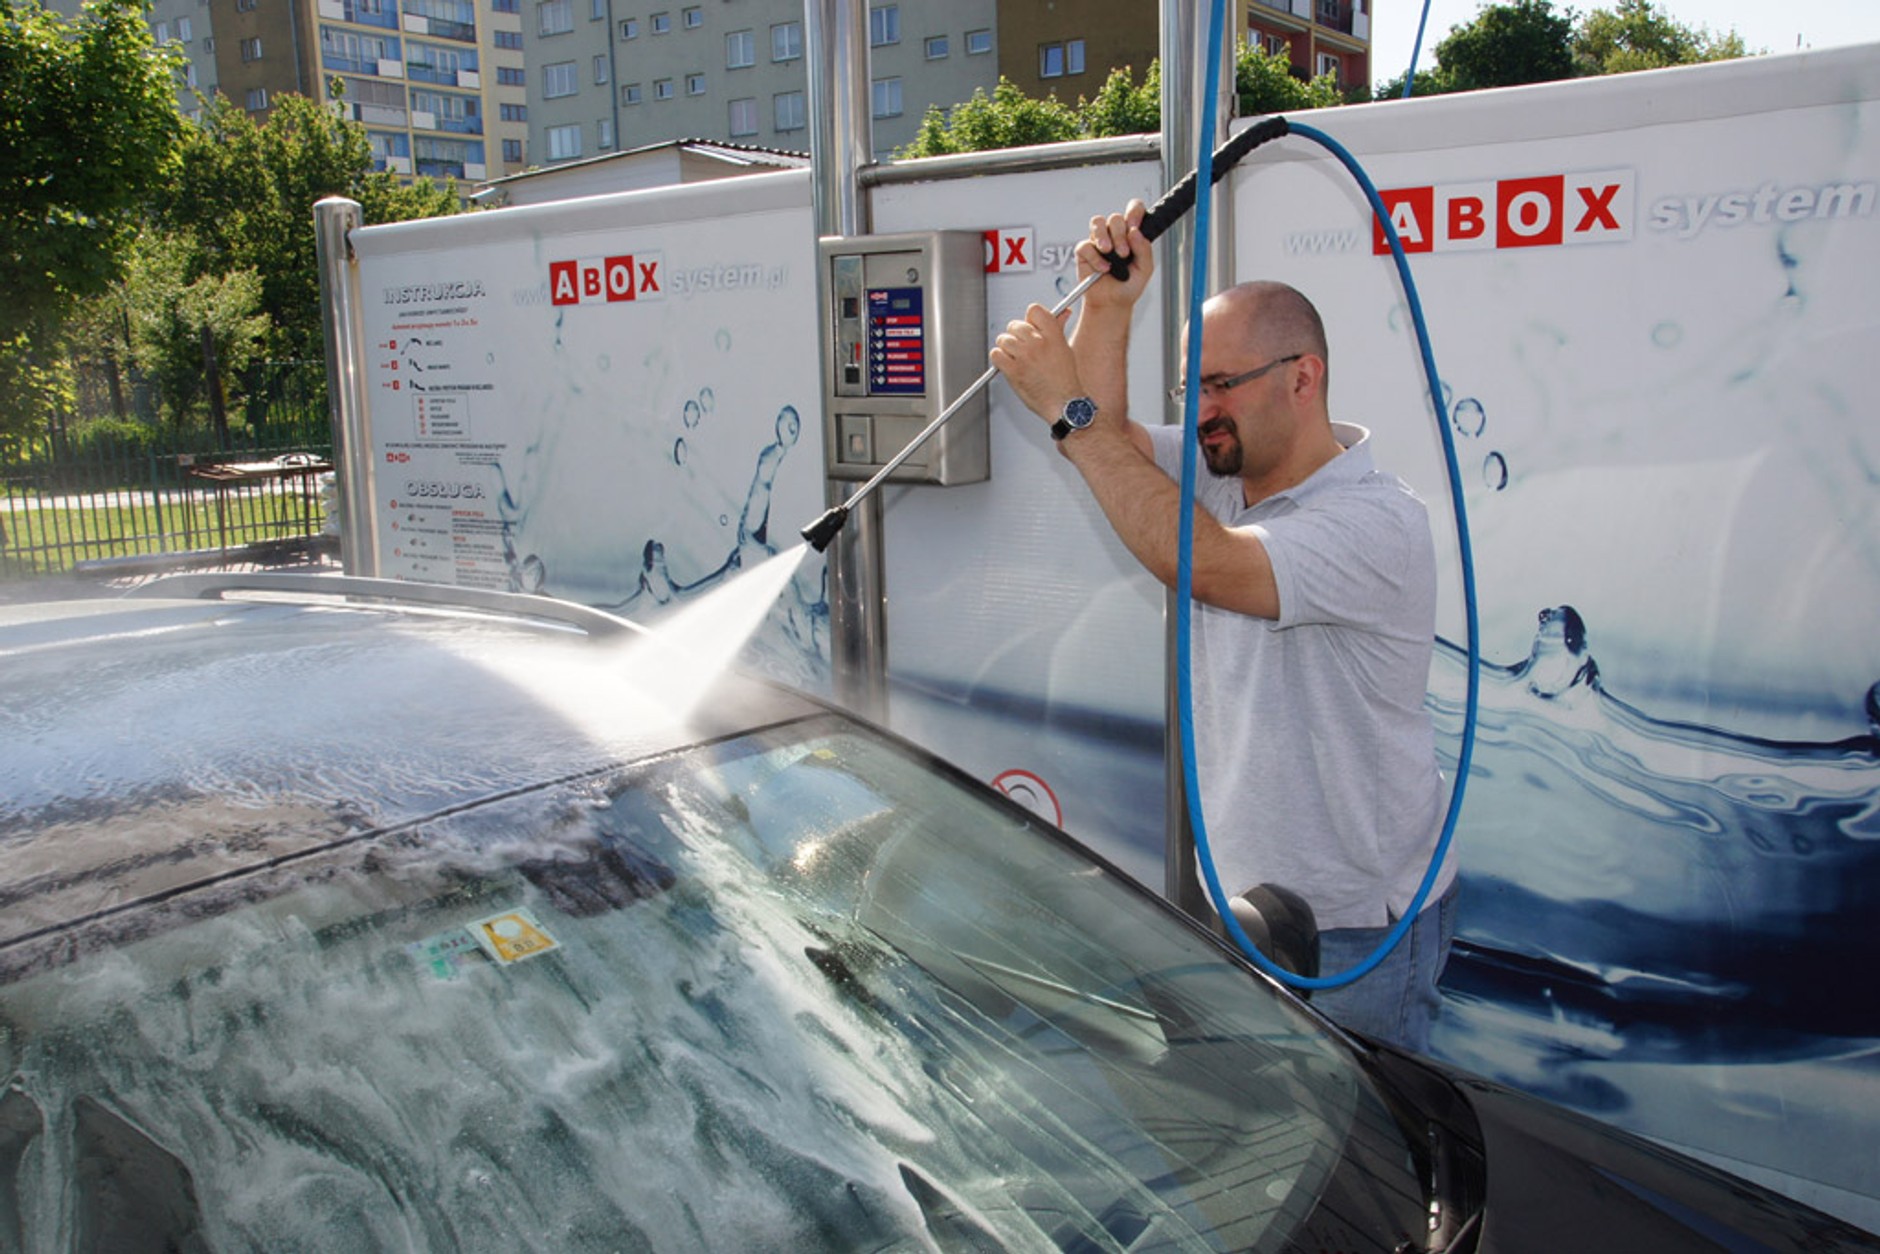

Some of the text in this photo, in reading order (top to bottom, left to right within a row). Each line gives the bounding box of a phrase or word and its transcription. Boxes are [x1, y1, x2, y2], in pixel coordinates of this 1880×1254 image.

[1381, 184, 1622, 246] ABOX
[1650, 181, 1878, 238] system
[1040, 243, 1075, 272] sy
[384, 280, 486, 305] INSTRUKCJA
[554, 261, 661, 300] ABOX
